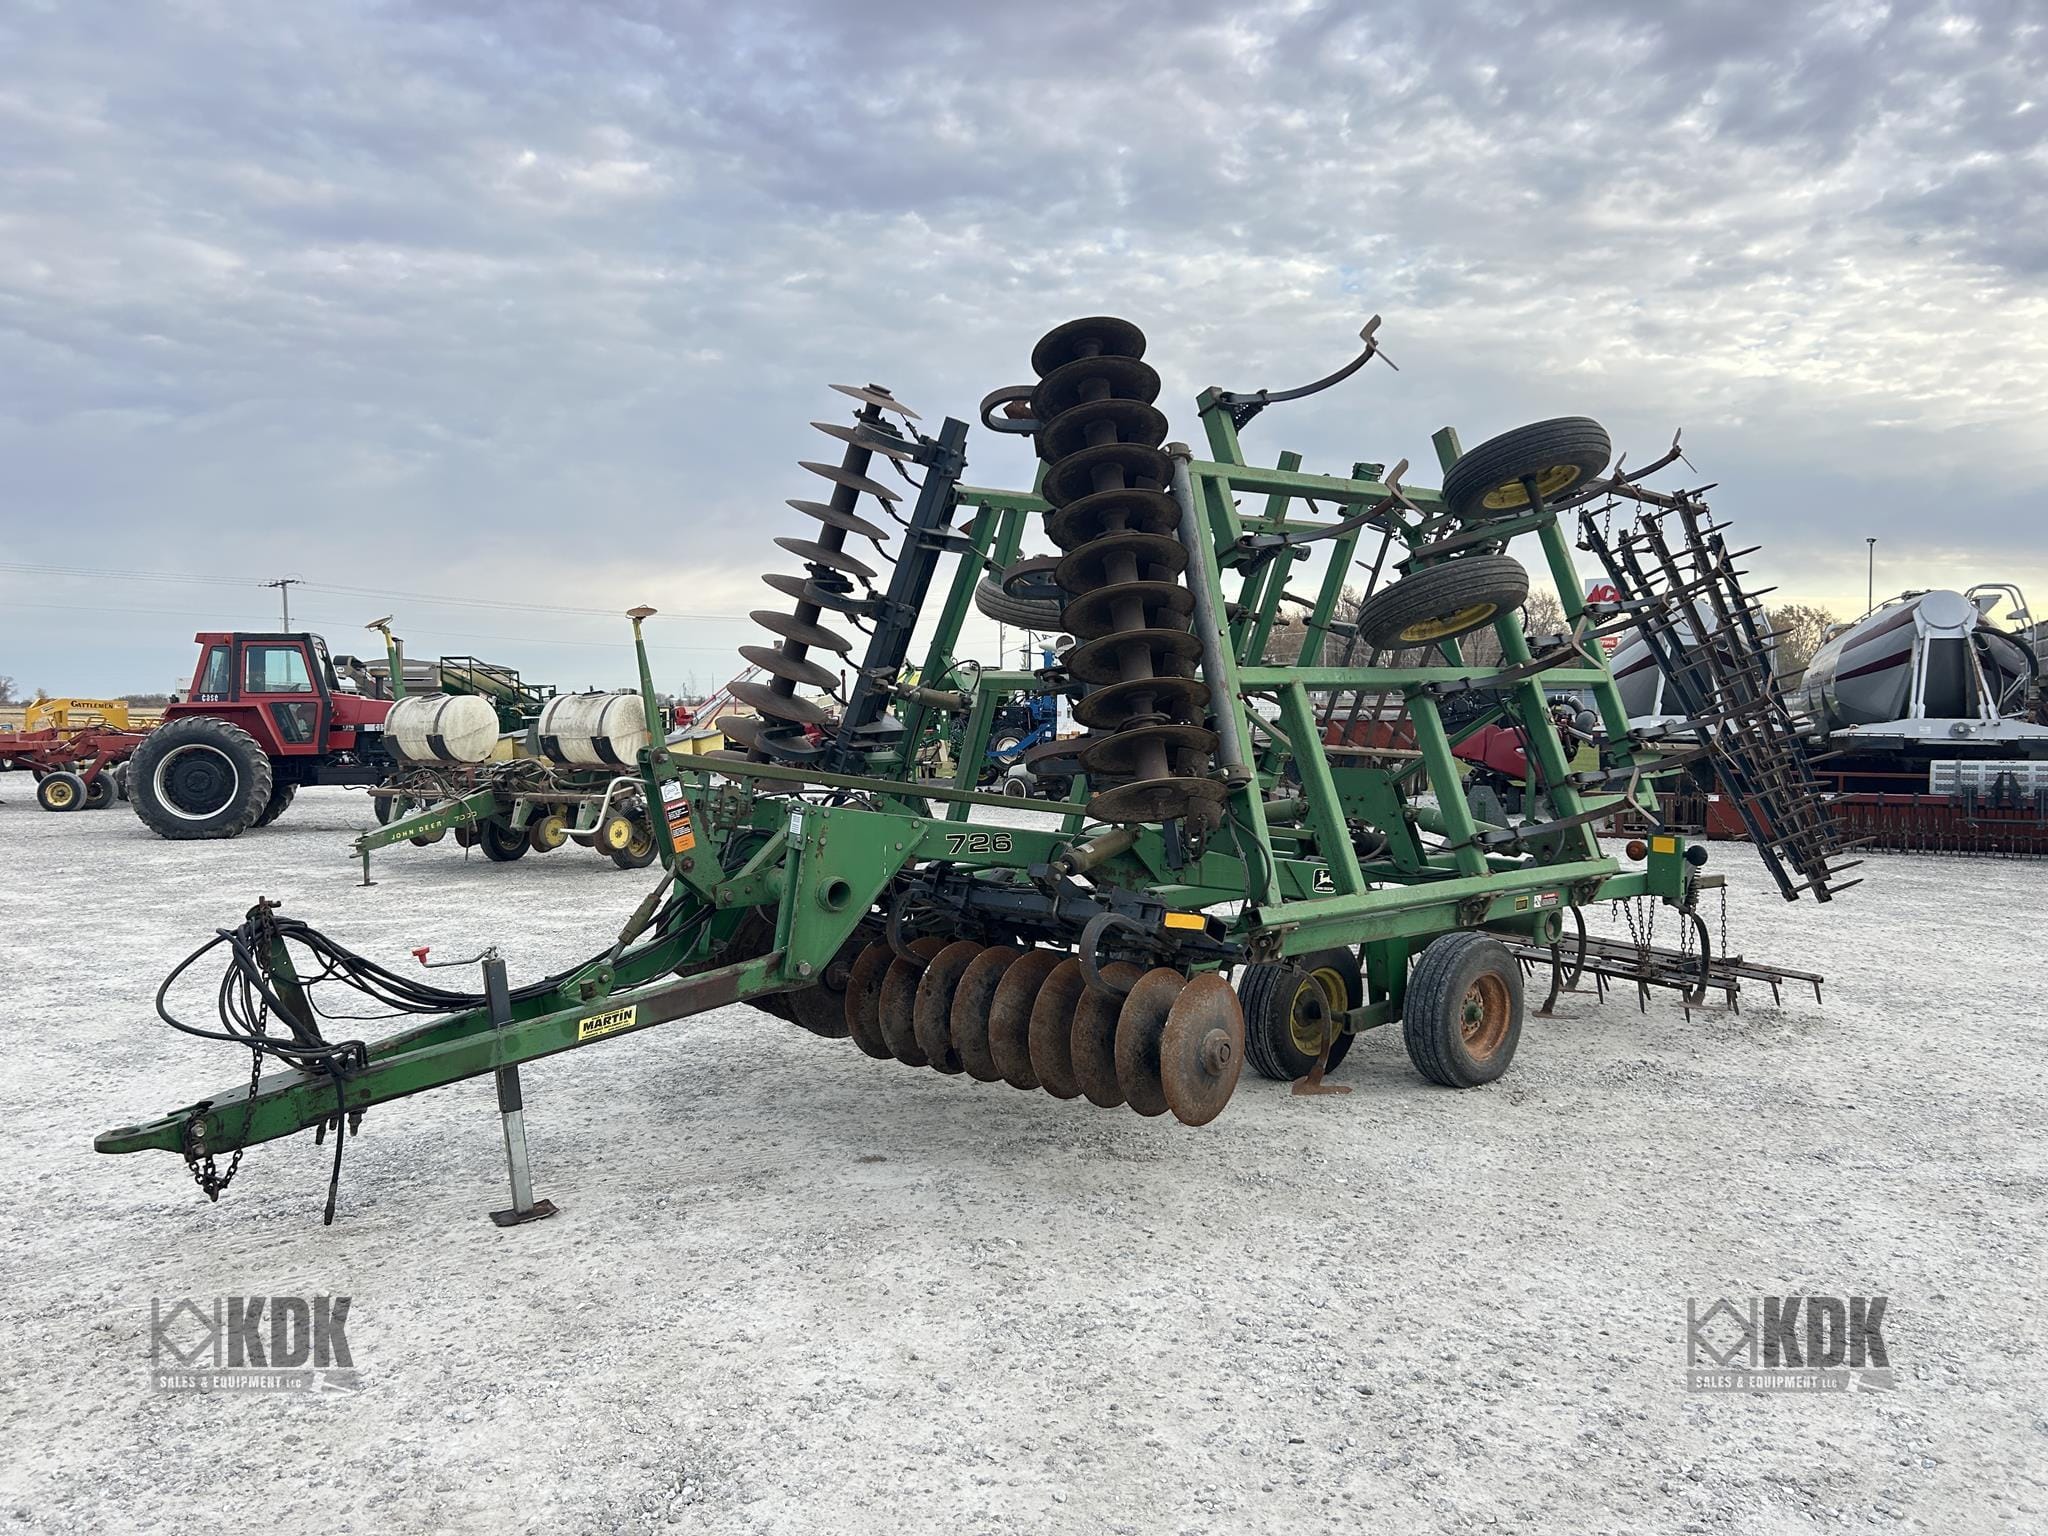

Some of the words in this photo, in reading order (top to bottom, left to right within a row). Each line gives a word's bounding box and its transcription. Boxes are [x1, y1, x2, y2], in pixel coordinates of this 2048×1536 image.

[391, 828, 414, 840] JOHN
[418, 820, 445, 832] DEER
[945, 832, 1013, 855] 726
[583, 1009, 632, 1032] MARTIN
